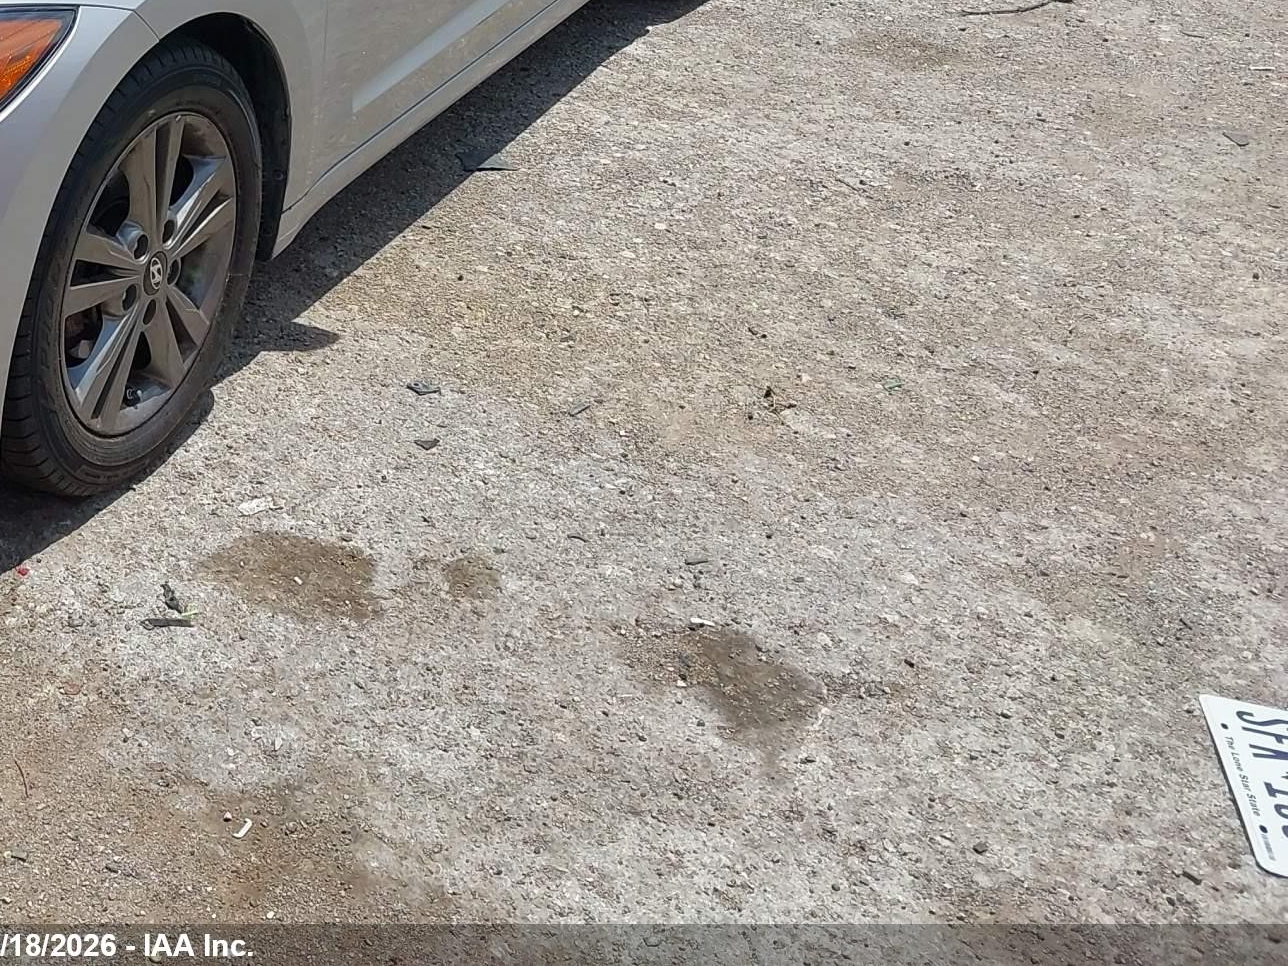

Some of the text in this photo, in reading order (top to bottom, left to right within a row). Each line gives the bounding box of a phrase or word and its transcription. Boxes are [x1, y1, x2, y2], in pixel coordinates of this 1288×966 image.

[1224, 736, 1261, 817] The Lone Star State
